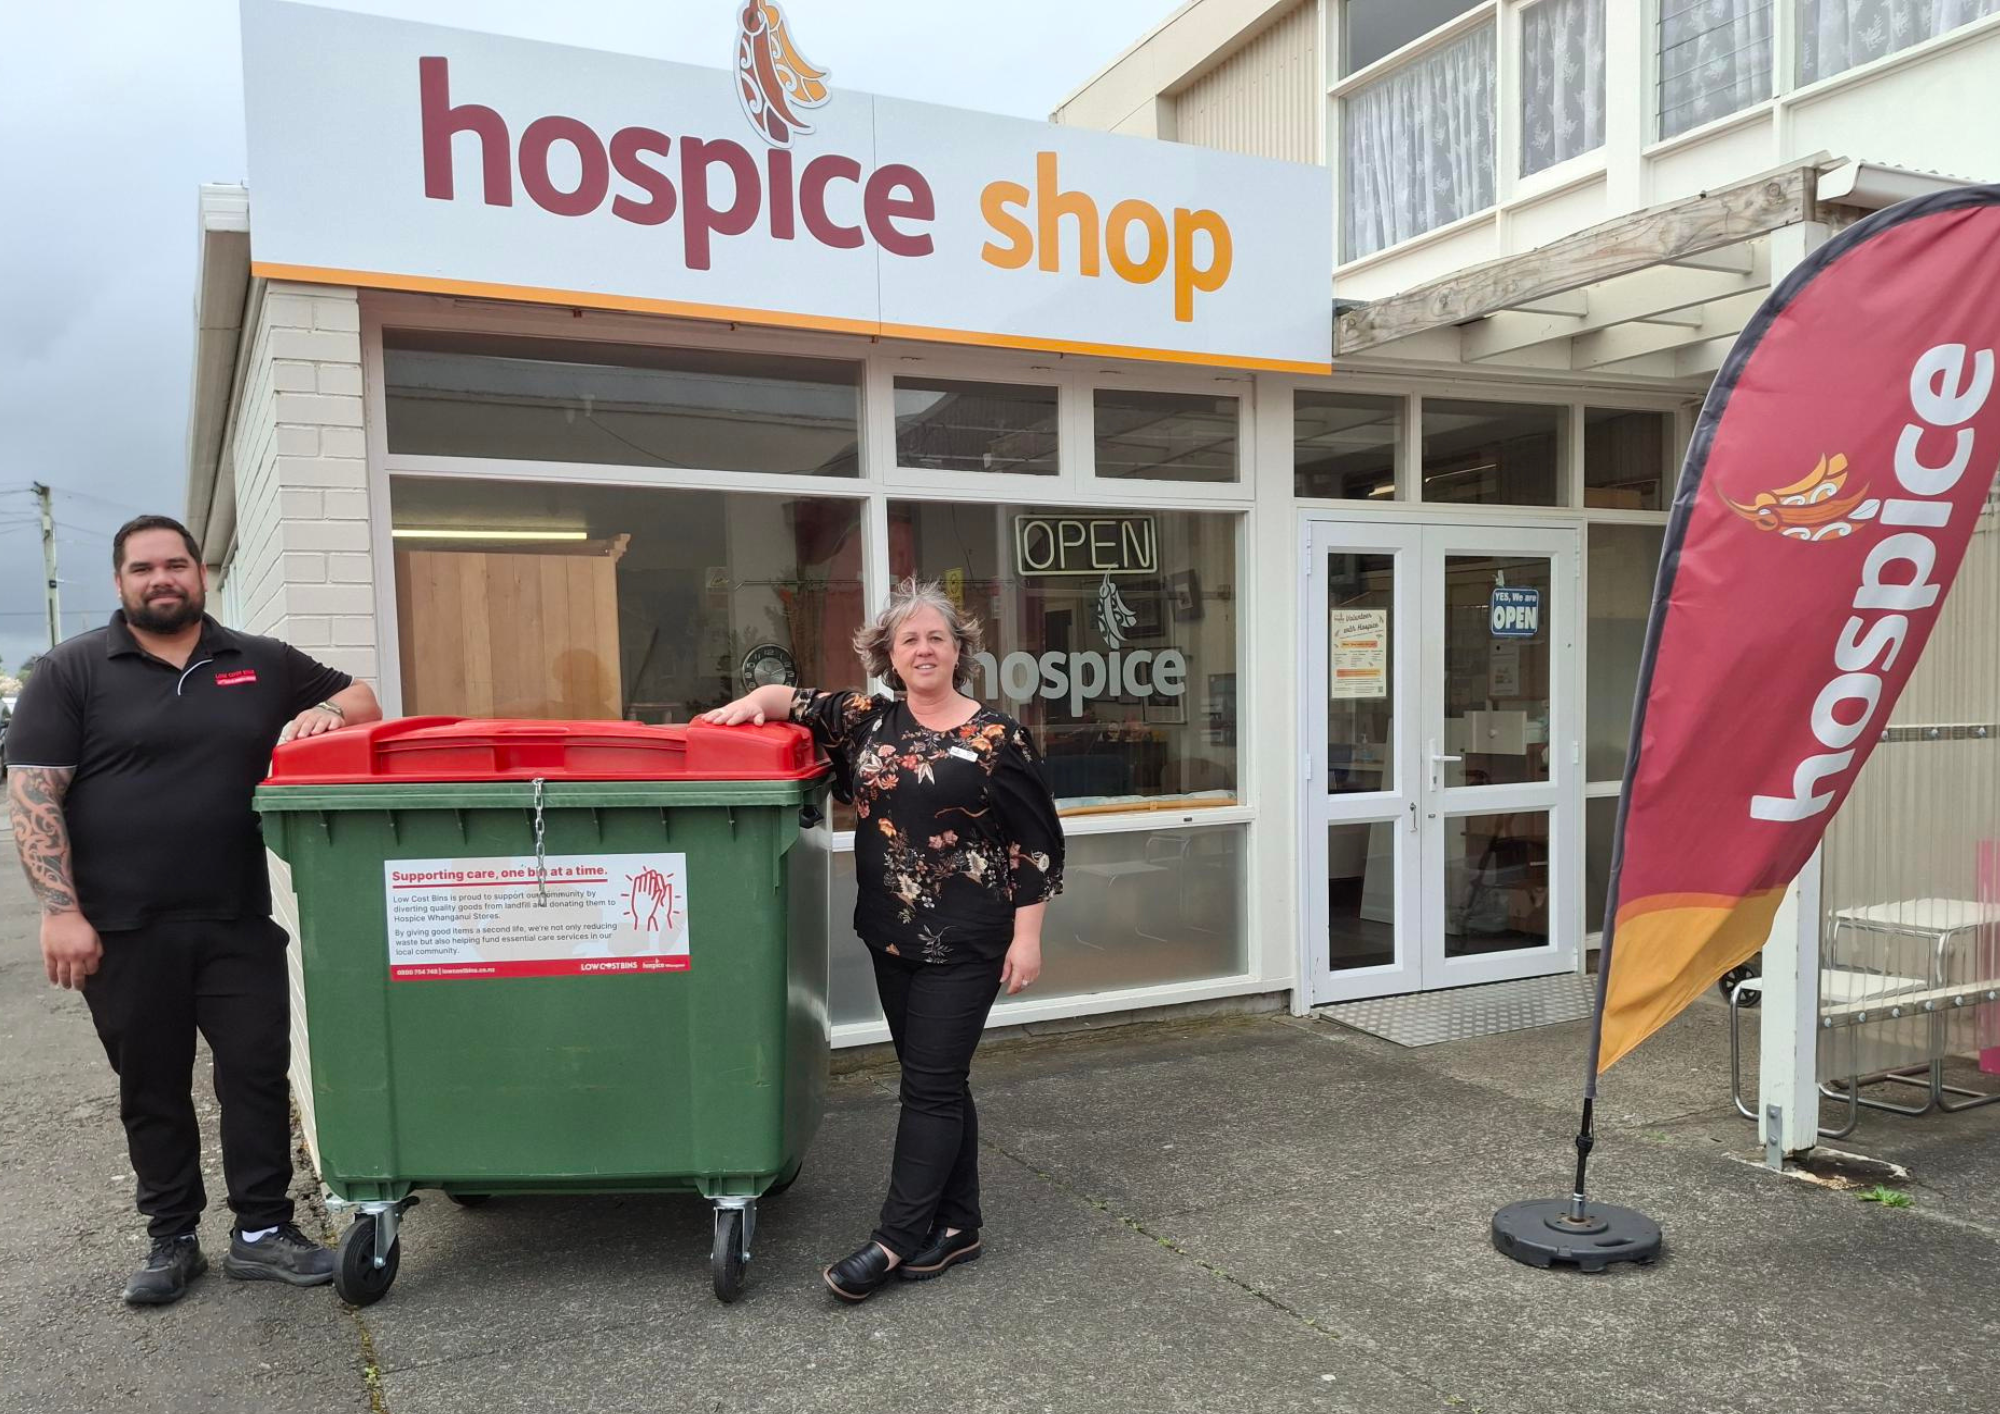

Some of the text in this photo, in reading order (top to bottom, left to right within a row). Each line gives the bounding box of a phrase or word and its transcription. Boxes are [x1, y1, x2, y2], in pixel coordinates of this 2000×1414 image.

[418, 55, 1234, 322] hospice shop
[1023, 520, 1151, 569] OPEN
[1750, 343, 1994, 822] hospice
[1495, 592, 1537, 603] YES, We are
[1493, 605, 1537, 629] OPEN
[392, 868, 464, 883] Supporting
[466, 868, 498, 880] care,
[501, 869, 525, 878] one
[550, 867, 563, 876] at
[566, 868, 573, 876] a
[576, 865, 608, 876] time.
[412, 895, 430, 903] Cost
[458, 893, 482, 903] proud
[494, 892, 524, 902] support
[586, 890, 596, 899] by
[394, 904, 428, 914] diverting
[430, 904, 456, 912] quality
[458, 903, 483, 912] goods
[484, 902, 504, 910] from
[550, 899, 584, 909] donating
[586, 899, 606, 907] them
[394, 914, 426, 923] Hospice
[428, 914, 472, 922] Whanganui
[395, 929, 404, 938] By
[406, 928, 430, 938] giving
[431, 928, 452, 937] good
[452, 926, 474, 934] items
[482, 926, 510, 934] second
[512, 926, 527, 934] life,
[550, 924, 564, 932] not
[566, 924, 582, 932] only
[583, 922, 618, 932] reducing
[420, 938, 433, 946] but
[452, 936, 481, 946] helping
[556, 933, 588, 942] services
[396, 947, 460, 956] local community.
